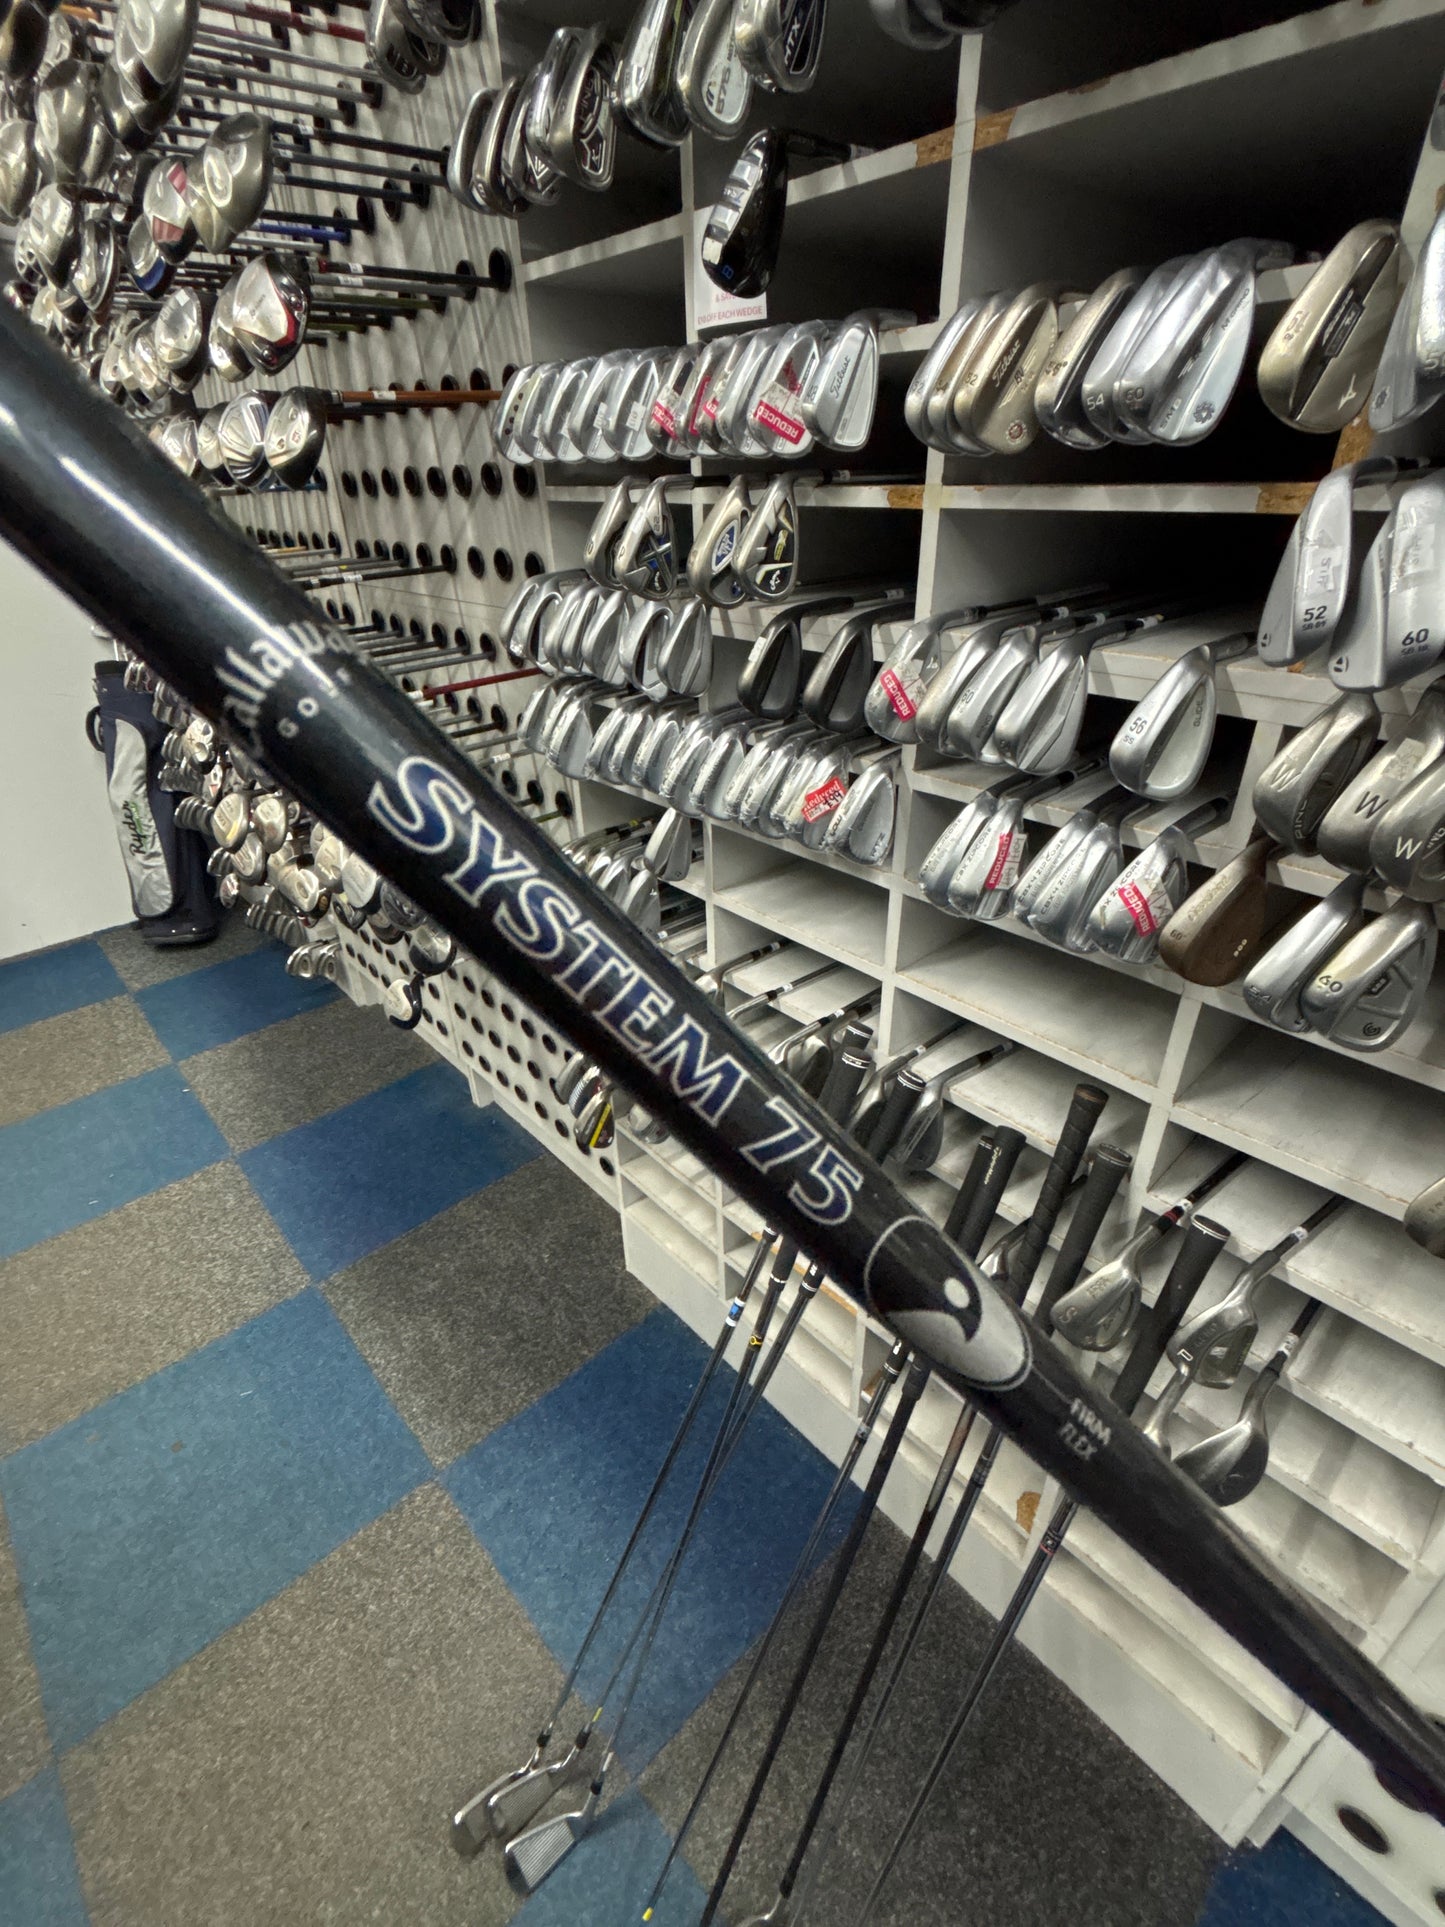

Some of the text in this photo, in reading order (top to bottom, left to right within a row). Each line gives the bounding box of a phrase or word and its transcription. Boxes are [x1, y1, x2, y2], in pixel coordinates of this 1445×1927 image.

[717, 309, 735, 319] EACH
[735, 305, 763, 317] WEDGE
[1085, 393, 1105, 412] 54
[757, 404, 799, 439] REDUCED
[1303, 605, 1328, 622] 52
[1401, 628, 1430, 647] 60
[883, 673, 911, 717] REDUCED
[1129, 717, 1148, 735] 56
[1270, 763, 1302, 792] W
[1354, 791, 1389, 819] W
[122, 800, 147, 856] Ryder
[988, 835, 1010, 885] REDUCED
[1395, 836, 1423, 860] W
[1123, 882, 1151, 933] REDUCED
[368, 755, 865, 1226] SYSTEM 75
[1317, 974, 1344, 994] 60
[1059, 1306, 1079, 1324] S
[1069, 1398, 1111, 1447] FIRM
[1058, 1421, 1099, 1462] FLEX
